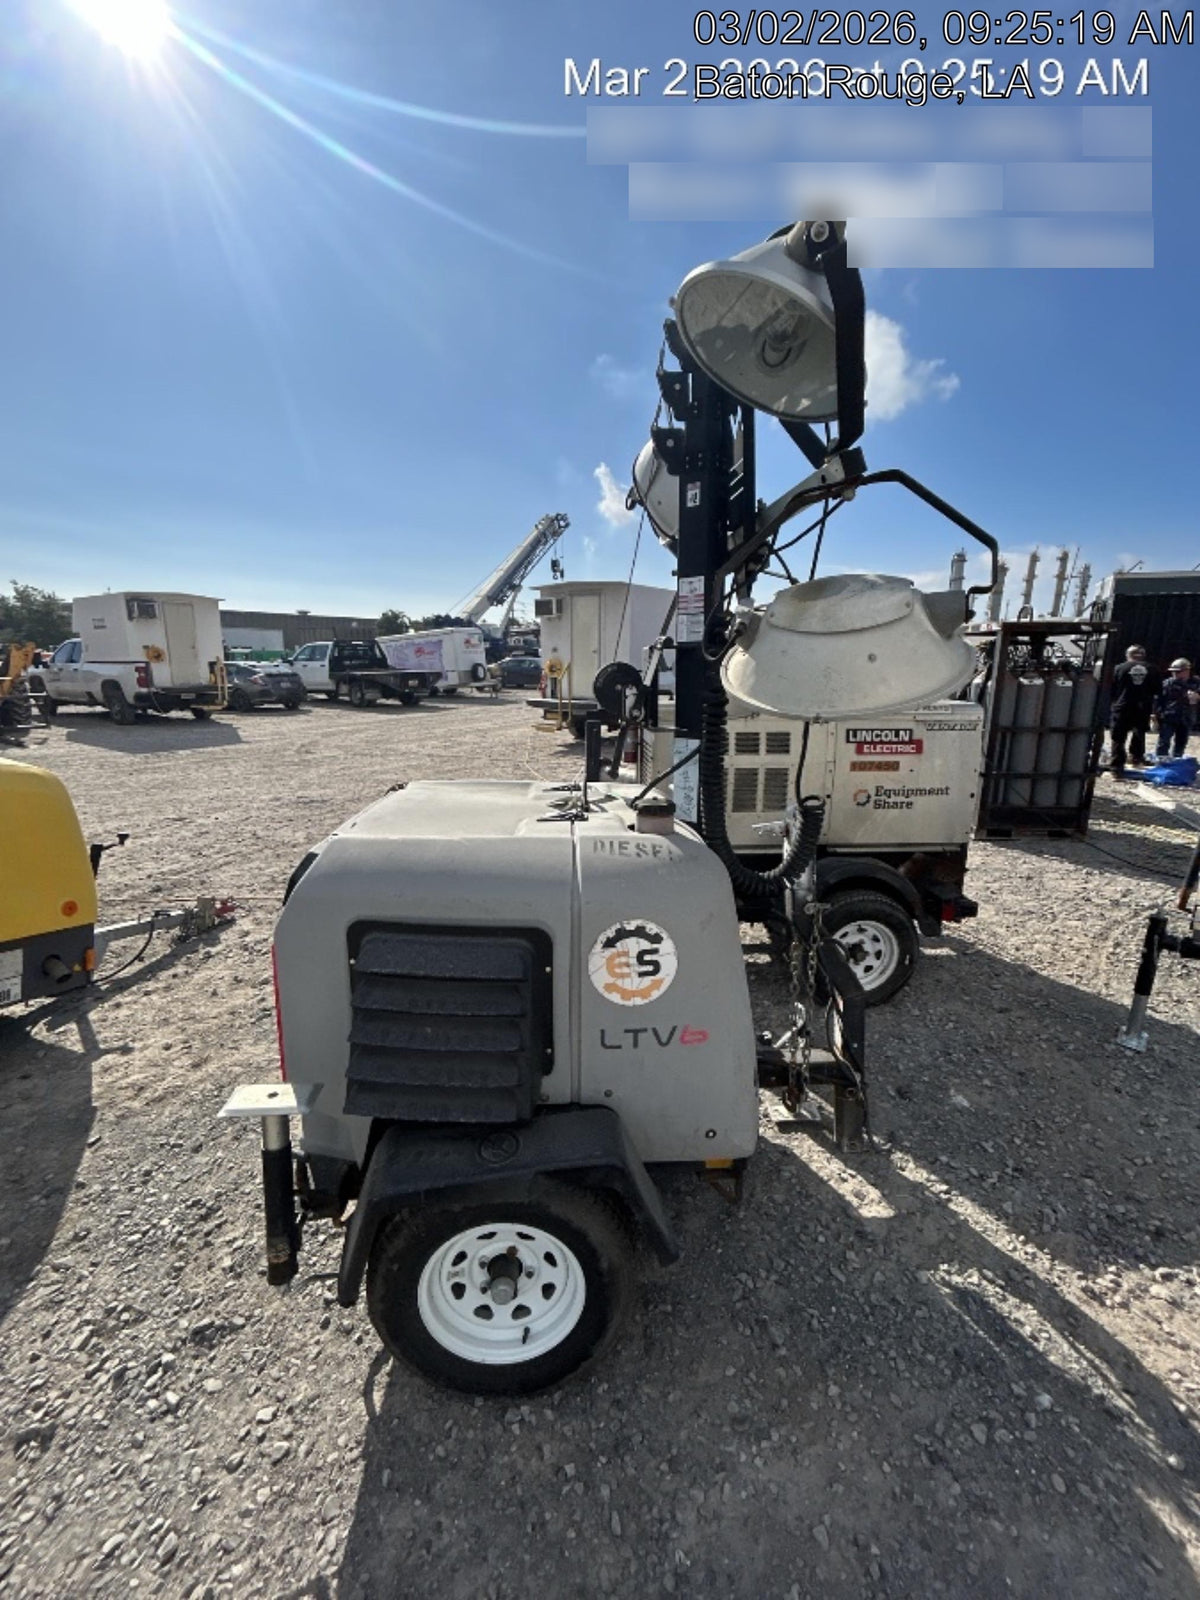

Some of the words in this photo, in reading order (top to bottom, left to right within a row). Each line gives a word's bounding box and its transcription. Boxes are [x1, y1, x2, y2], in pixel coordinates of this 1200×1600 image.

[849, 730, 910, 742] LINCOLN
[863, 744, 917, 753] ELECTRIC
[874, 785, 950, 799] Equipment
[873, 799, 914, 810] Share
